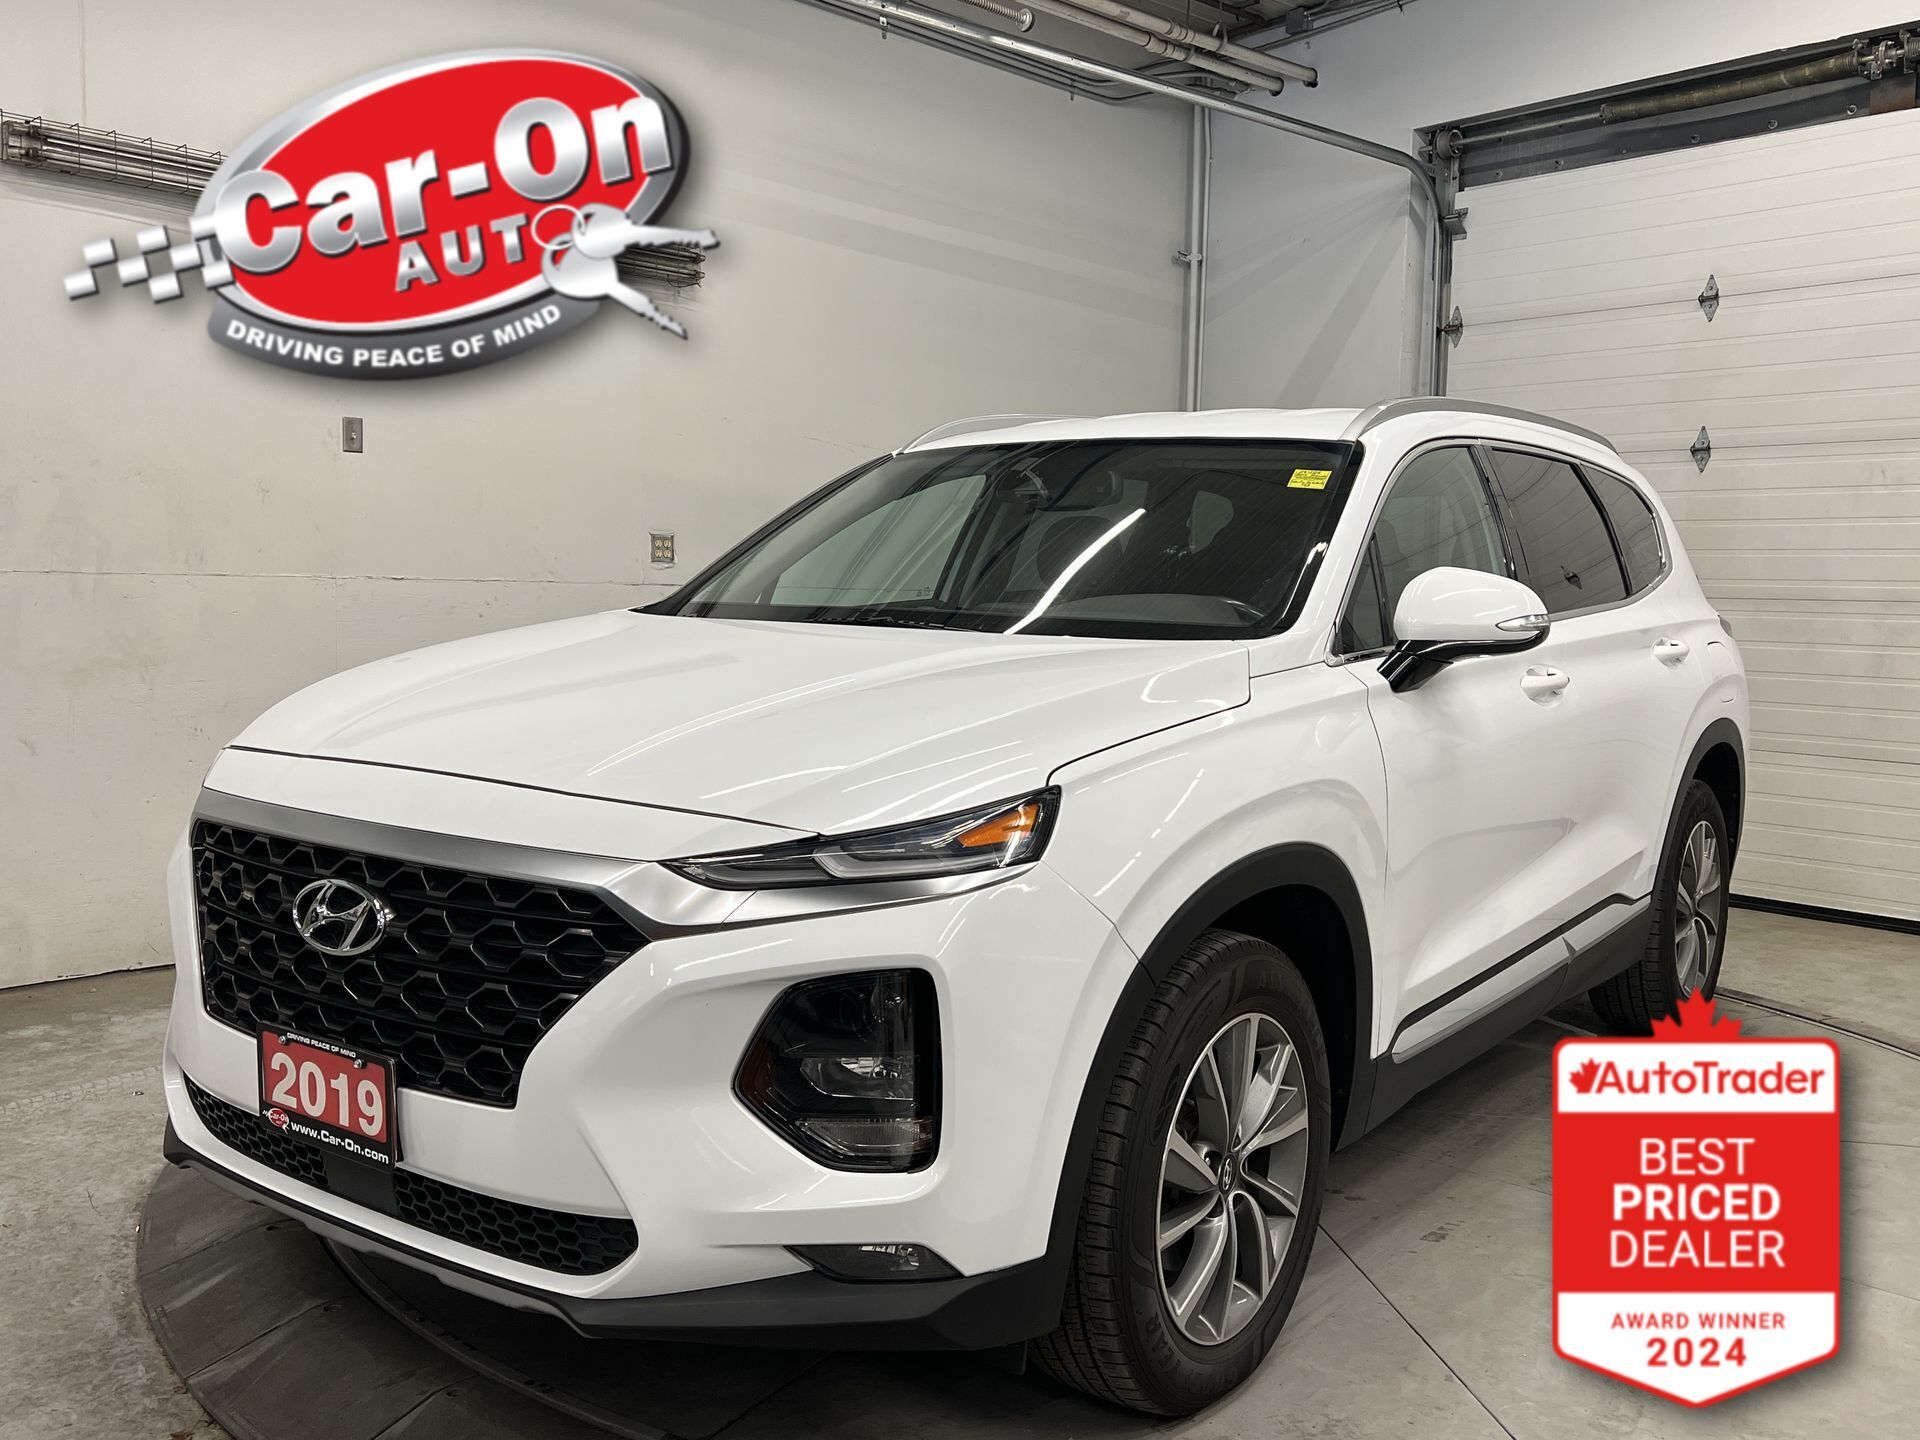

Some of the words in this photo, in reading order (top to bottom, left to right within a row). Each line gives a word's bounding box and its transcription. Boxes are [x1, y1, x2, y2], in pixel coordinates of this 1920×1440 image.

[286, 1032, 310, 1044] DRIVING
[311, 1039, 330, 1051] PEACE
[331, 1045, 340, 1053] OF
[340, 1048, 356, 1058] MIND
[271, 1052, 383, 1136] 2019
[290, 1121, 389, 1165] www.Car-On.com
